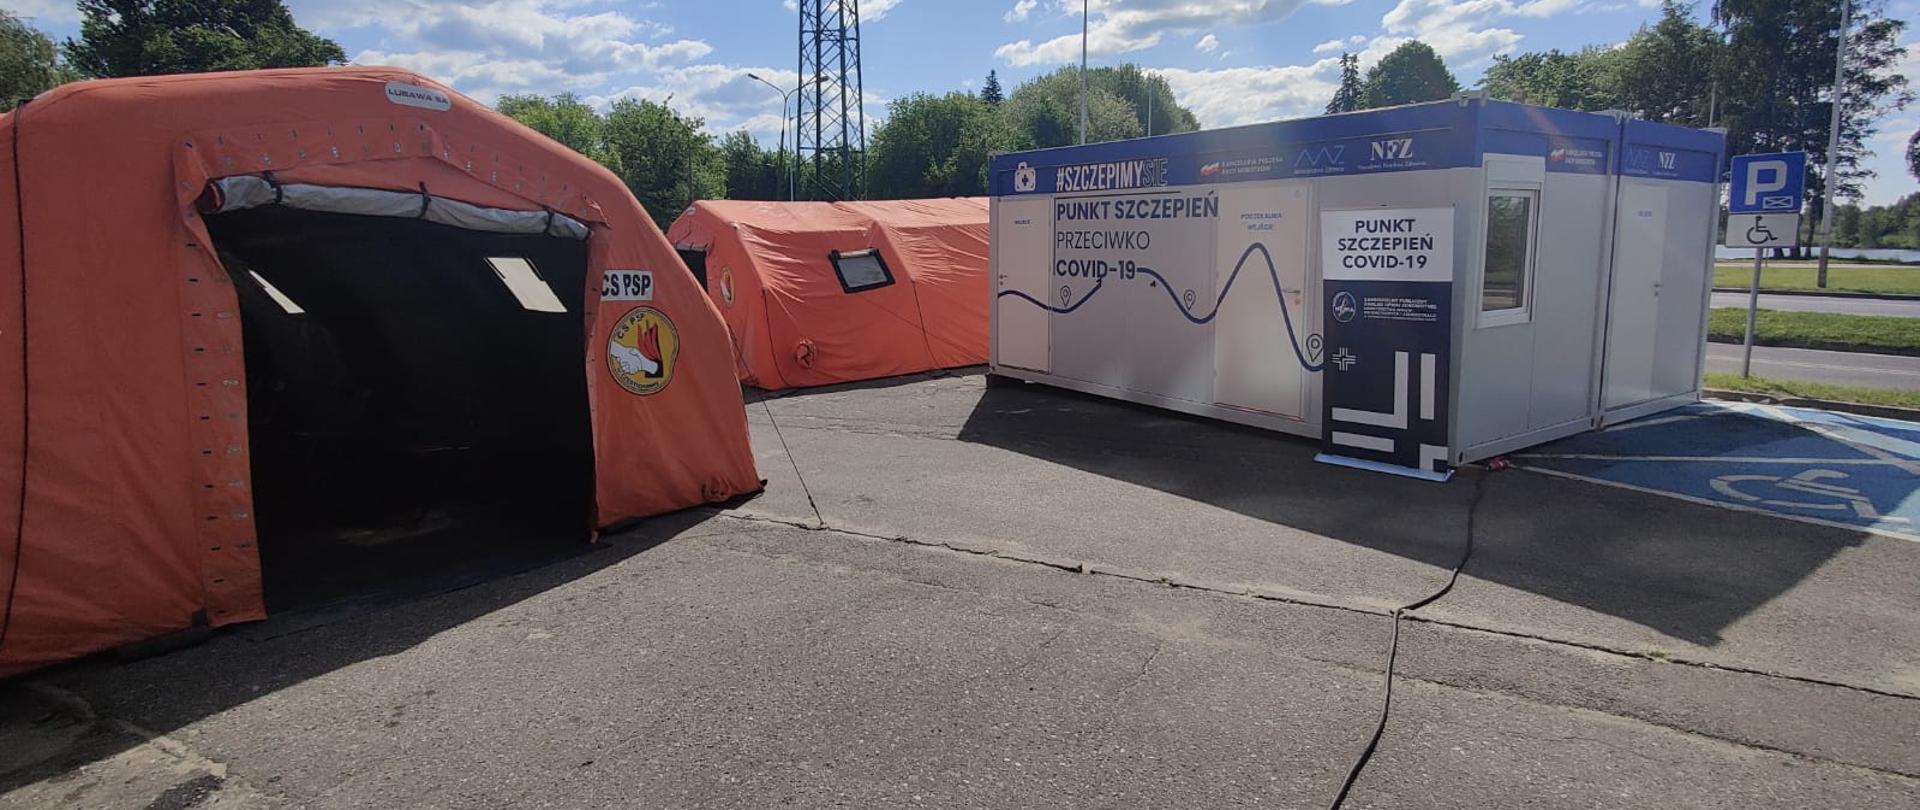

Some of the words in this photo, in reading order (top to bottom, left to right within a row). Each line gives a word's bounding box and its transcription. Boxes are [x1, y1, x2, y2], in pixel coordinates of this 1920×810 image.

[388, 88, 433, 101] LUBAWA
[1370, 138, 1413, 161] NFZ
[1744, 160, 1788, 206] P
[1057, 201, 1111, 221] PUNKT
[1114, 191, 1219, 220] SZCZEPIEŃ
[1355, 218, 1416, 234] PUNKT
[1056, 230, 1150, 250] PRZECIWKO
[1338, 233, 1434, 251] SZCZEPIEŃ
[1056, 259, 1136, 280] COVID-19
[1342, 255, 1428, 269] COVID-19
[602, 274, 620, 296] CS
[622, 274, 651, 296] PSP
